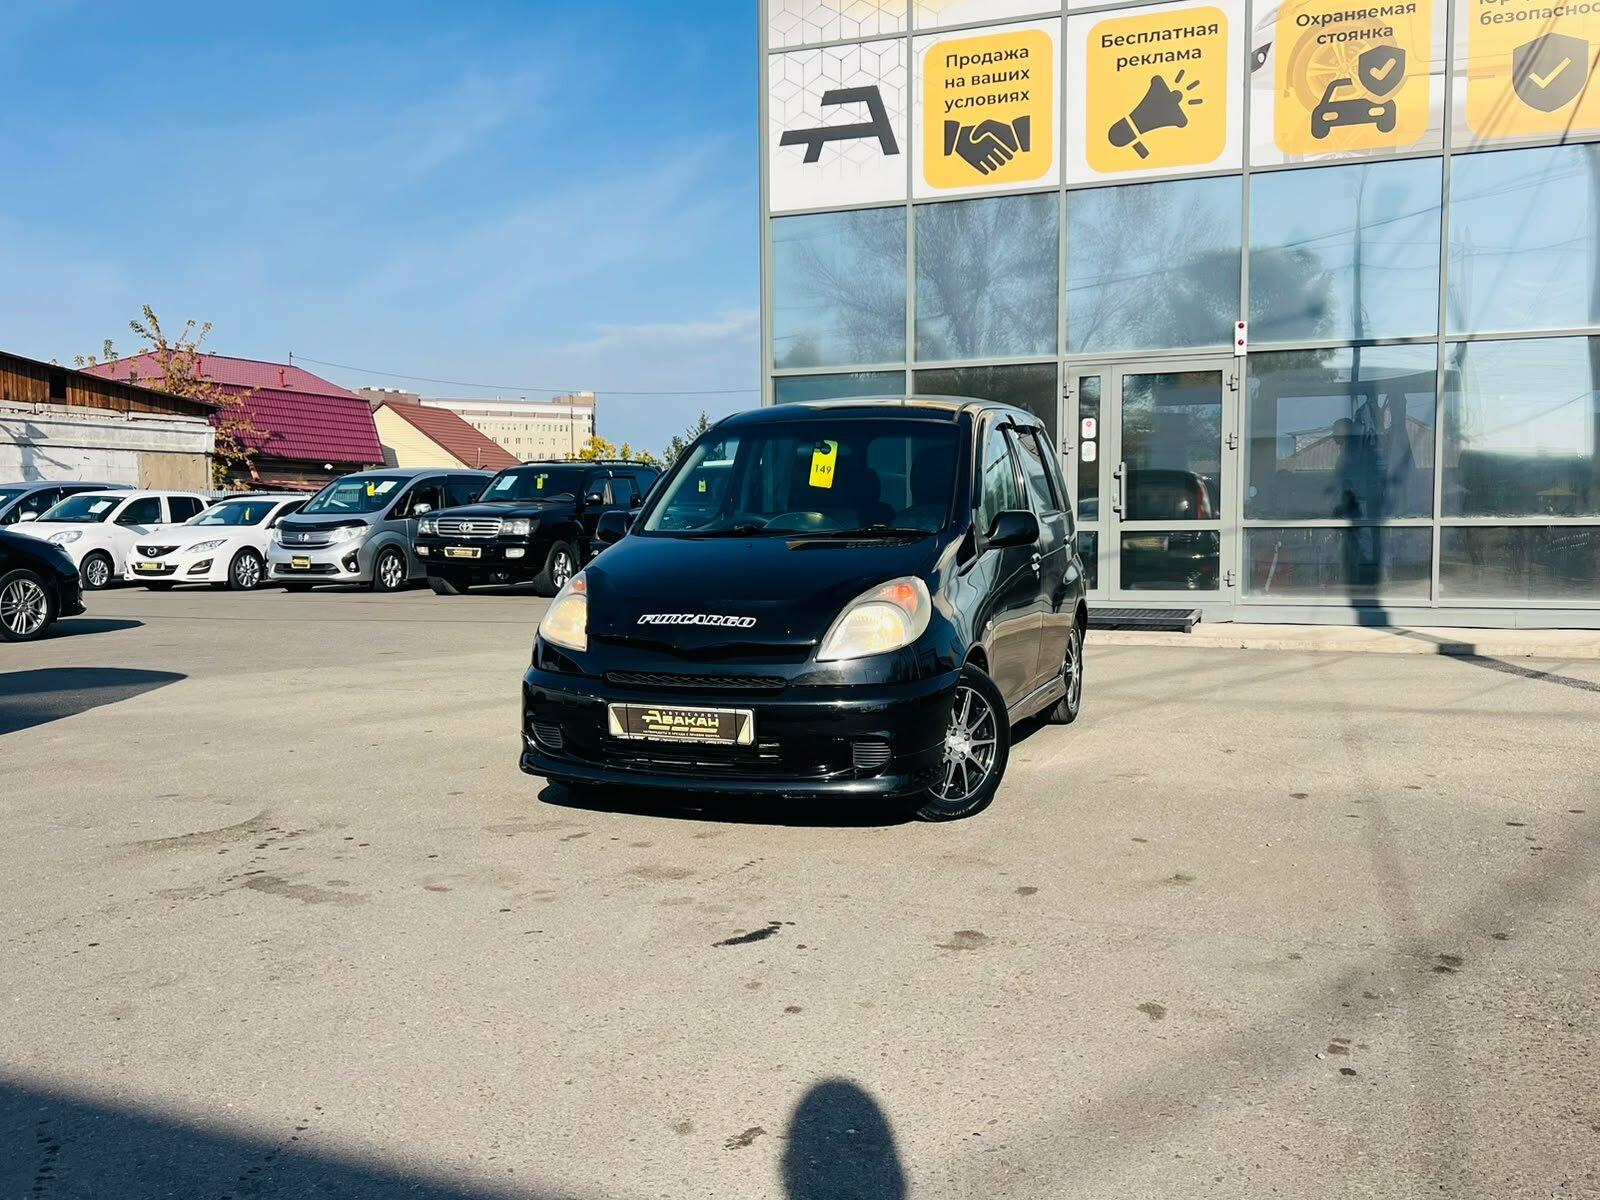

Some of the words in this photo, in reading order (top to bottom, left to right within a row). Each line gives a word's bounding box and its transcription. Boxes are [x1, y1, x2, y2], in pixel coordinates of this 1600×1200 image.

[1296, 2, 1417, 28] Охраняемая
[1101, 22, 1219, 49] Бесплатная
[1316, 25, 1394, 45] стоянка
[945, 47, 1030, 69] Продажа
[1116, 47, 1202, 71] реклама
[944, 76, 966, 90] на
[970, 67, 1030, 87] ваших
[944, 89, 1030, 113] условиях
[815, 464, 832, 475] 149
